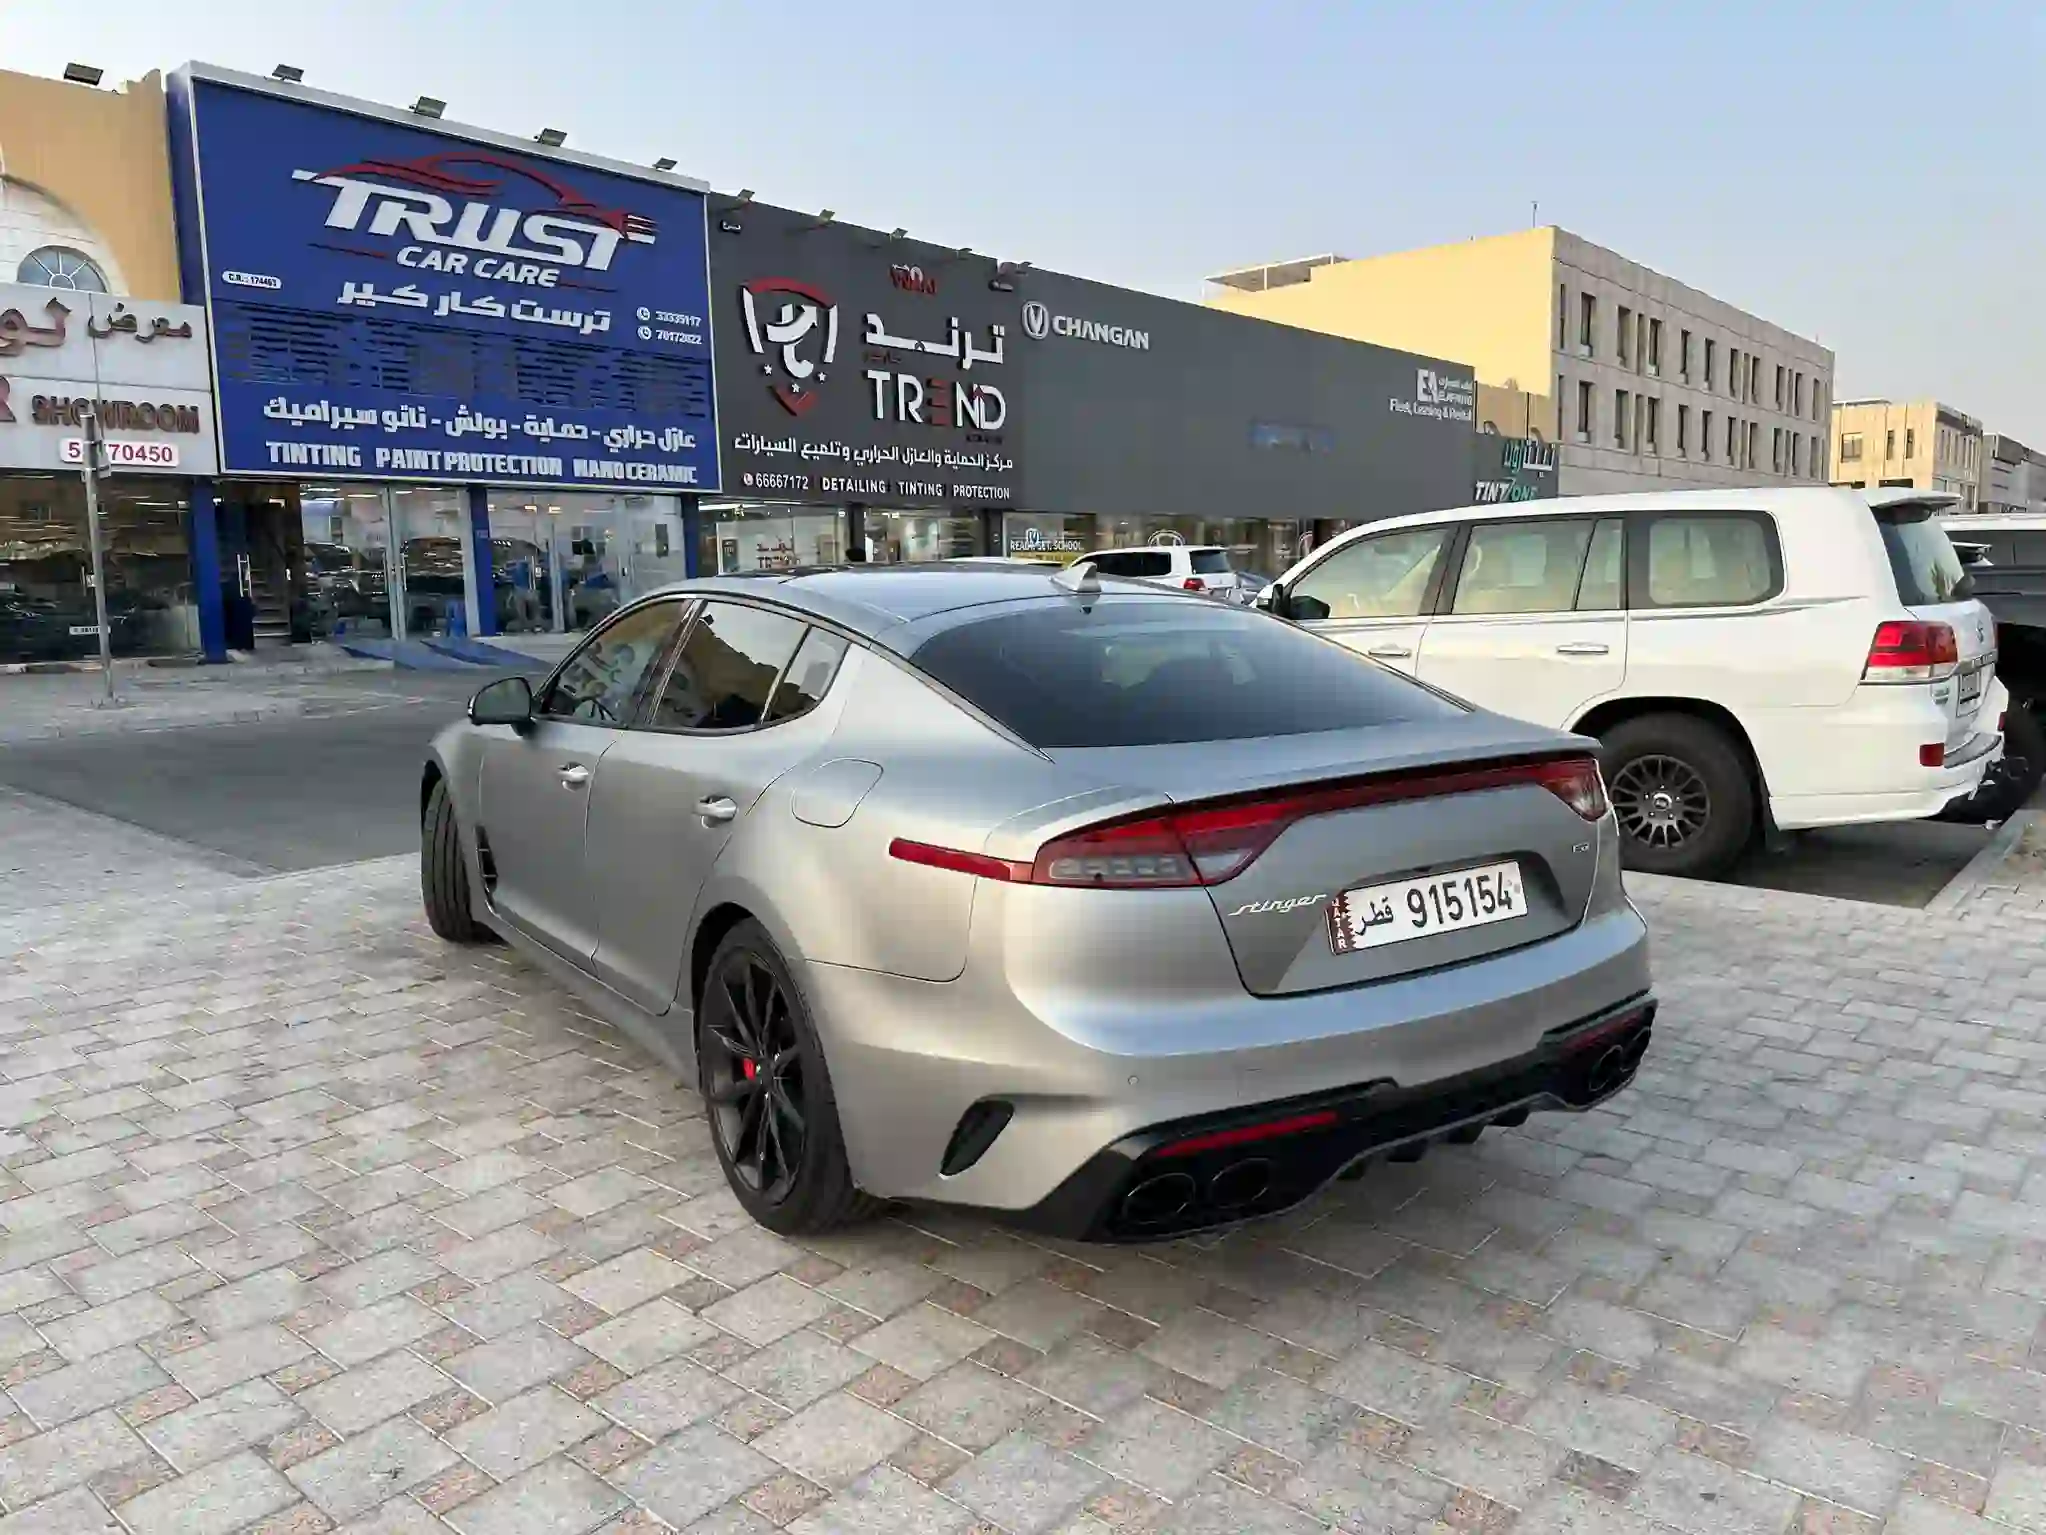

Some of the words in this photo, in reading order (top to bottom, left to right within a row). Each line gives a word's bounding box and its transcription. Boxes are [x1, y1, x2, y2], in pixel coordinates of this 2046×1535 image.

[292, 169, 656, 271] TRUST
[396, 246, 469, 275] CAR
[473, 258, 560, 288] CARE
[336, 283, 429, 307] كير
[433, 291, 505, 316] كار
[87, 302, 193, 344] معرض
[510, 299, 611, 334] ترست
[1052, 315, 1149, 350] CHANGAN
[866, 313, 1005, 371] ترند
[31, 395, 200, 434] SHOWROOM
[866, 369, 1007, 431] TREND
[445, 404, 507, 440] بولش
[523, 414, 589, 443] حماية
[68, 442, 173, 462] 570450
[657, 427, 696, 453] عازل
[734, 432, 797, 457] السيارات
[853, 444, 899, 467] الحراري
[265, 440, 362, 468] TINTING
[375, 447, 441, 472] PAINT
[443, 451, 563, 478] PROTECTION
[943, 448, 984, 470] الحماية
[984, 451, 1013, 472] مركز
[755, 472, 809, 490] 66667172
[822, 476, 886, 493] DETAILING
[898, 480, 943, 497] TINTING
[952, 484, 1011, 499] PROTECTION
[1355, 896, 1394, 937] قطر
[1406, 871, 1513, 929] 915154
[1331, 897, 1348, 950] QATAR
